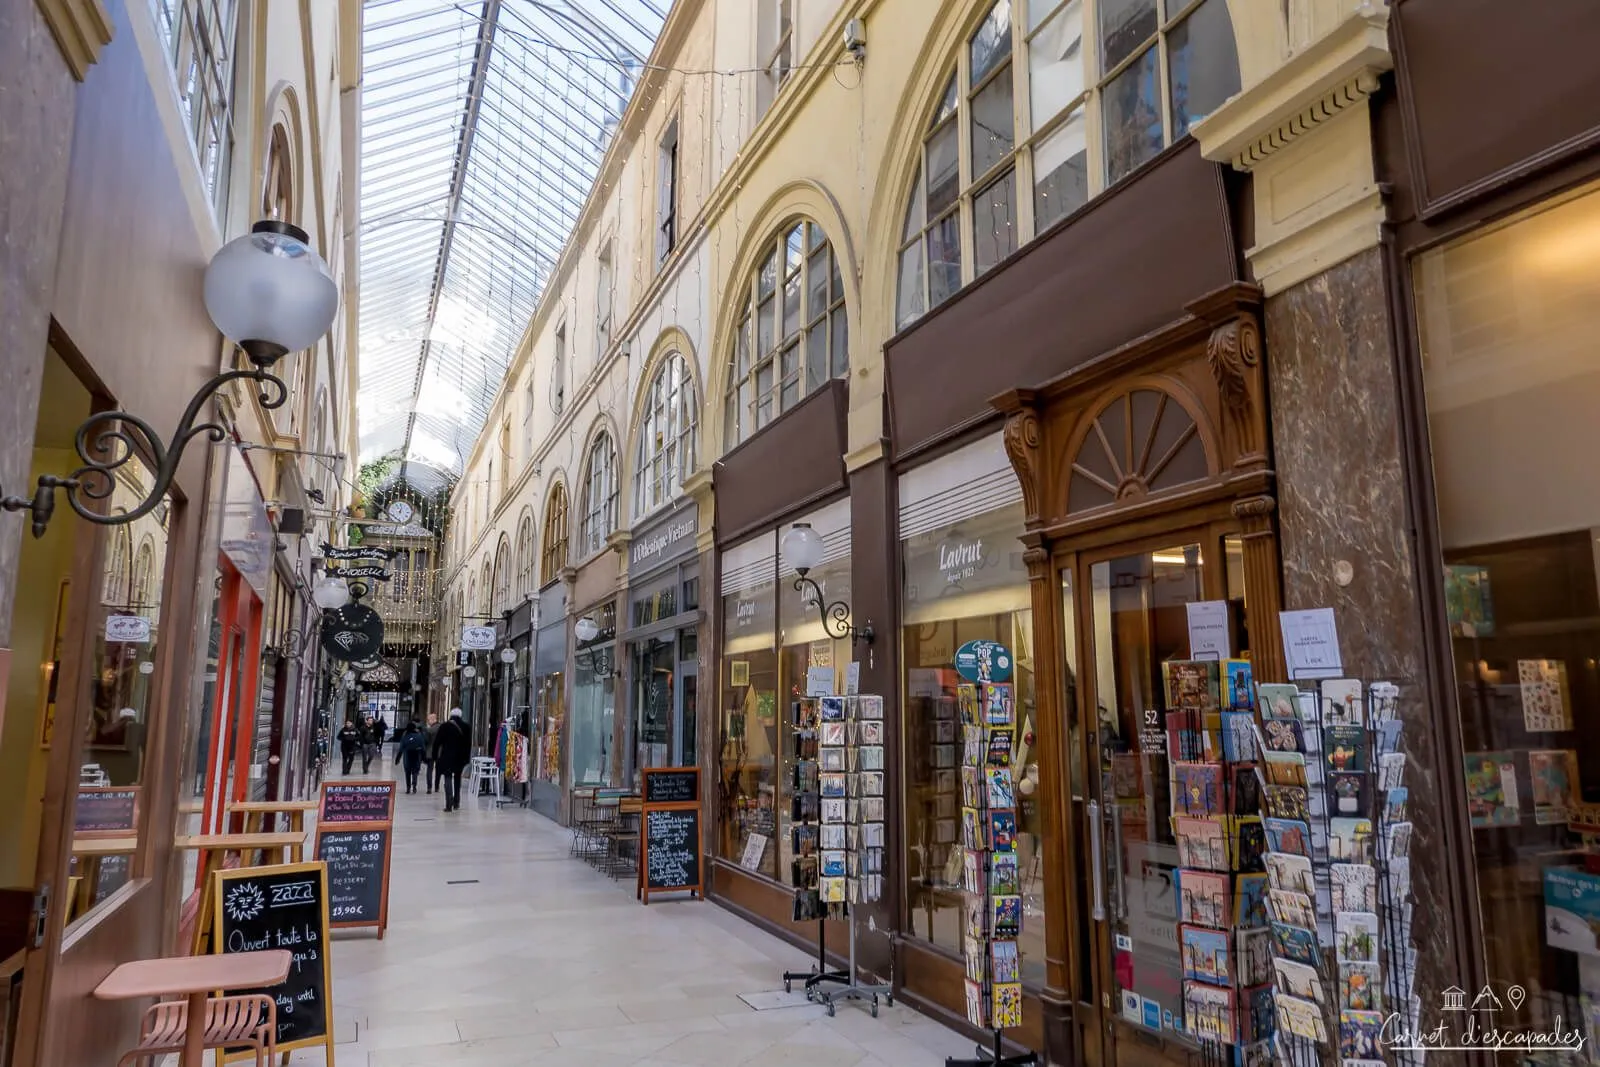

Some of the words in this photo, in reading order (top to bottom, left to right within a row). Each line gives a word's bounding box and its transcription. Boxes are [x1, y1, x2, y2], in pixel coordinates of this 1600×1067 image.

[940, 539, 982, 570] Lavrut
[1145, 710, 1158, 725] 52
[228, 929, 271, 953] Ouvert
[276, 926, 302, 946] toute
[276, 994, 294, 1013] day
[297, 988, 315, 1001] until
